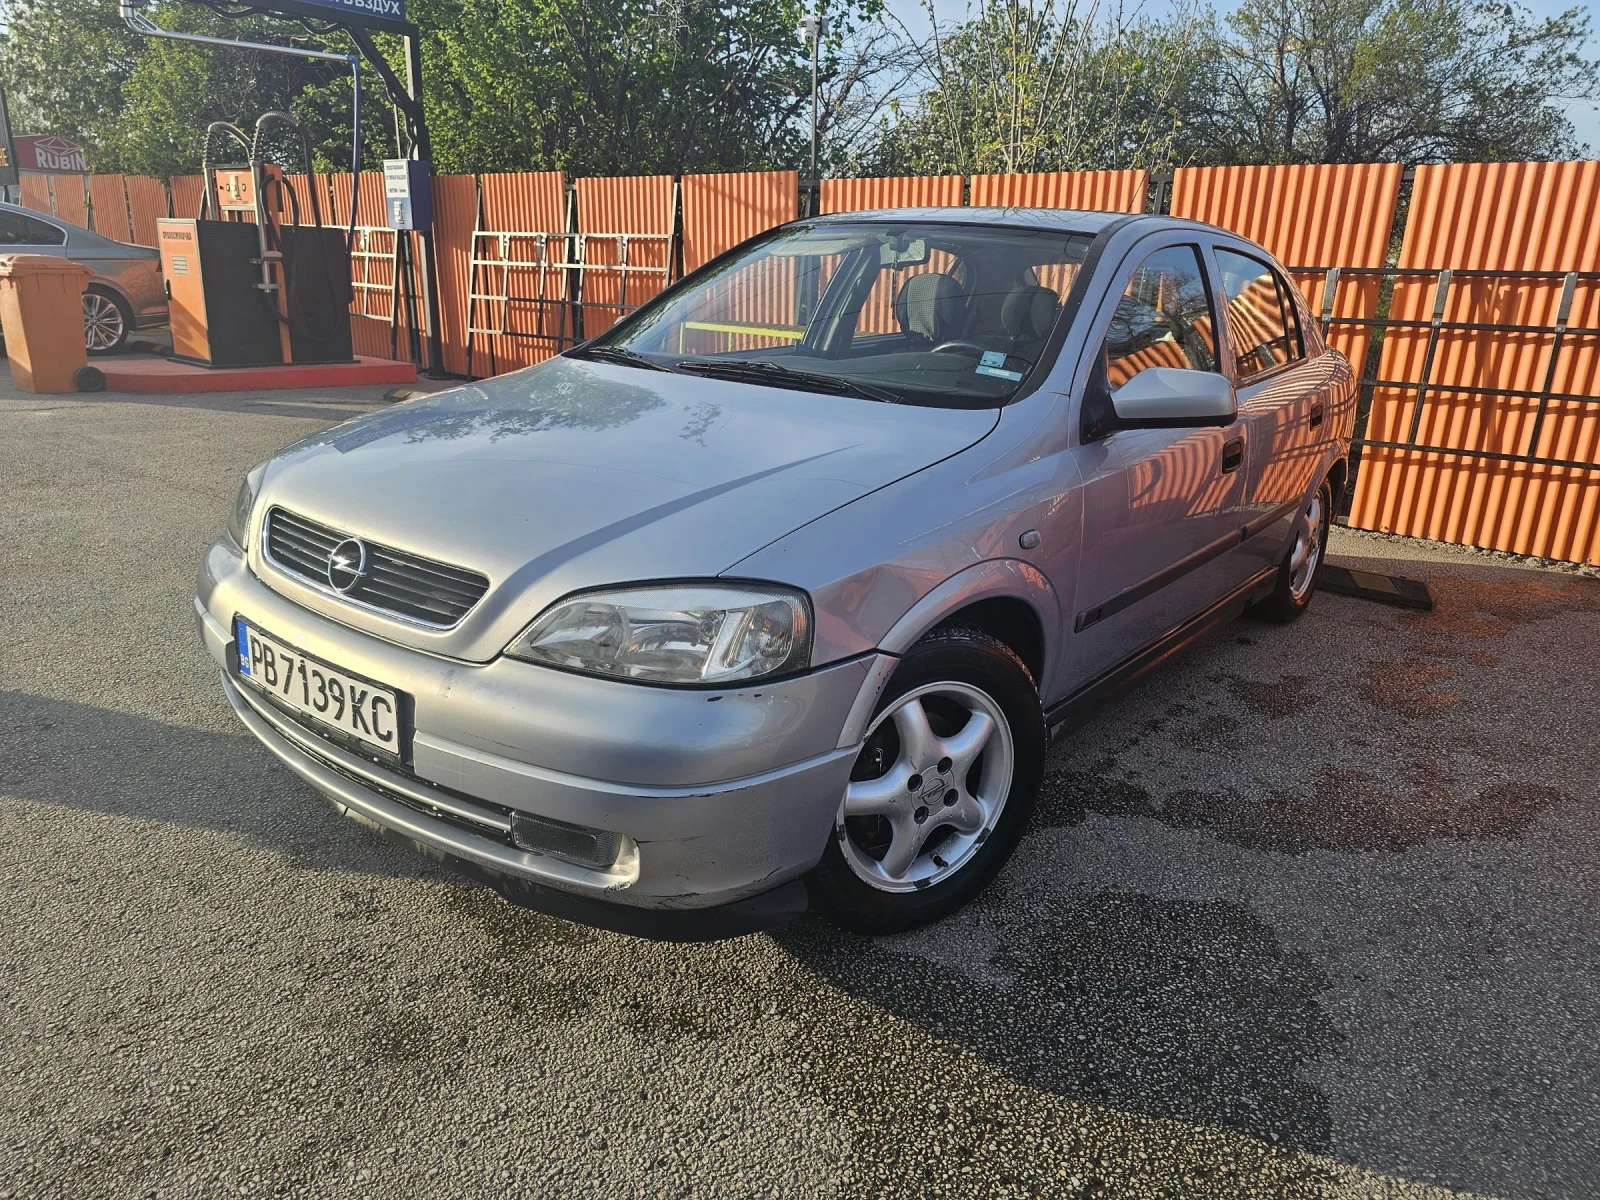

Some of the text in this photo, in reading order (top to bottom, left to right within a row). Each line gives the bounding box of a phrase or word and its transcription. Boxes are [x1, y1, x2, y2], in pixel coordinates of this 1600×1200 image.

[35, 147, 87, 171] RUBIN
[240, 653, 250, 668] BG
[251, 634, 393, 742] PB7139KC
